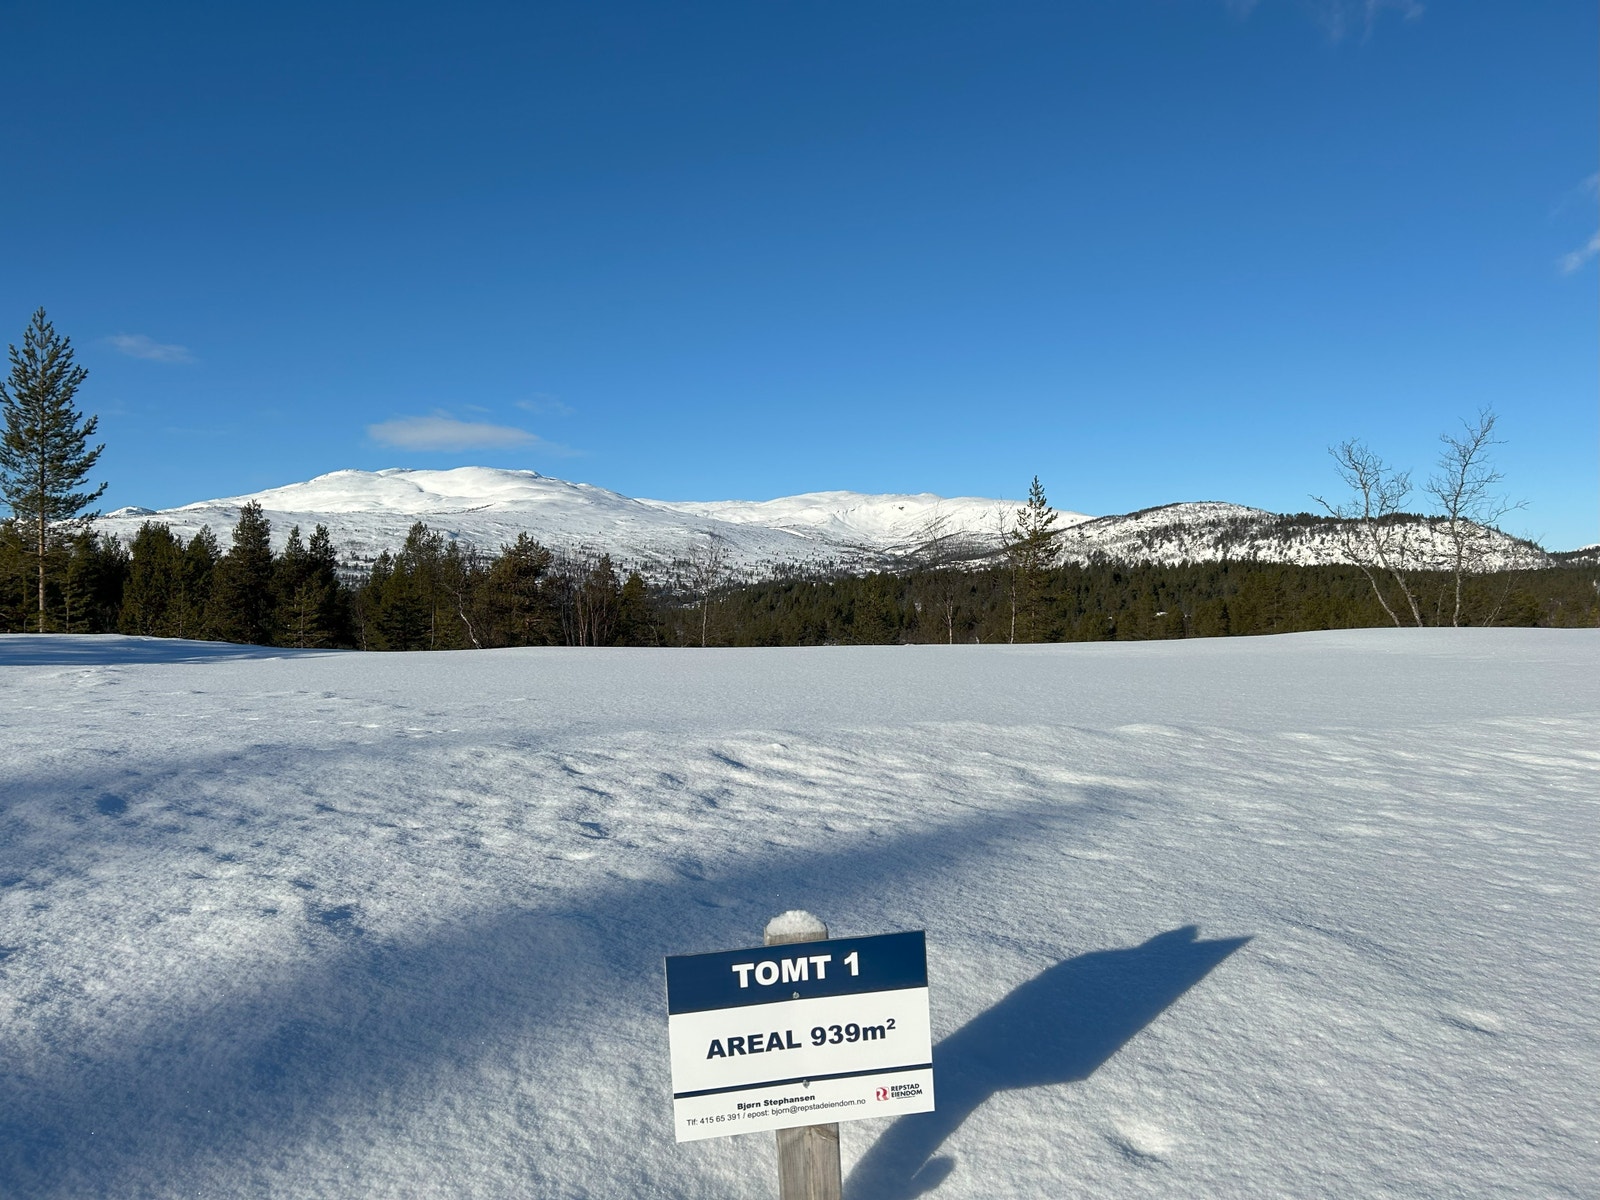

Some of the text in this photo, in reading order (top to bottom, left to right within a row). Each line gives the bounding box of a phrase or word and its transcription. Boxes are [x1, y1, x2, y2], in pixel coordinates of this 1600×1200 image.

[732, 952, 859, 988] TOMT 1
[706, 1018, 896, 1059] AREAL 939m²
[737, 1094, 816, 1110] Bjørn Stephansen
[891, 1089, 923, 1098] EIENDOM
[687, 1118, 698, 1126] Tlf:
[700, 1116, 714, 1124] 415
[715, 1114, 726, 1122] 65
[727, 1112, 740, 1121] 391
[747, 1109, 770, 1119] epost:
[771, 1098, 866, 1116] bjorn@repstadeiendom.no
